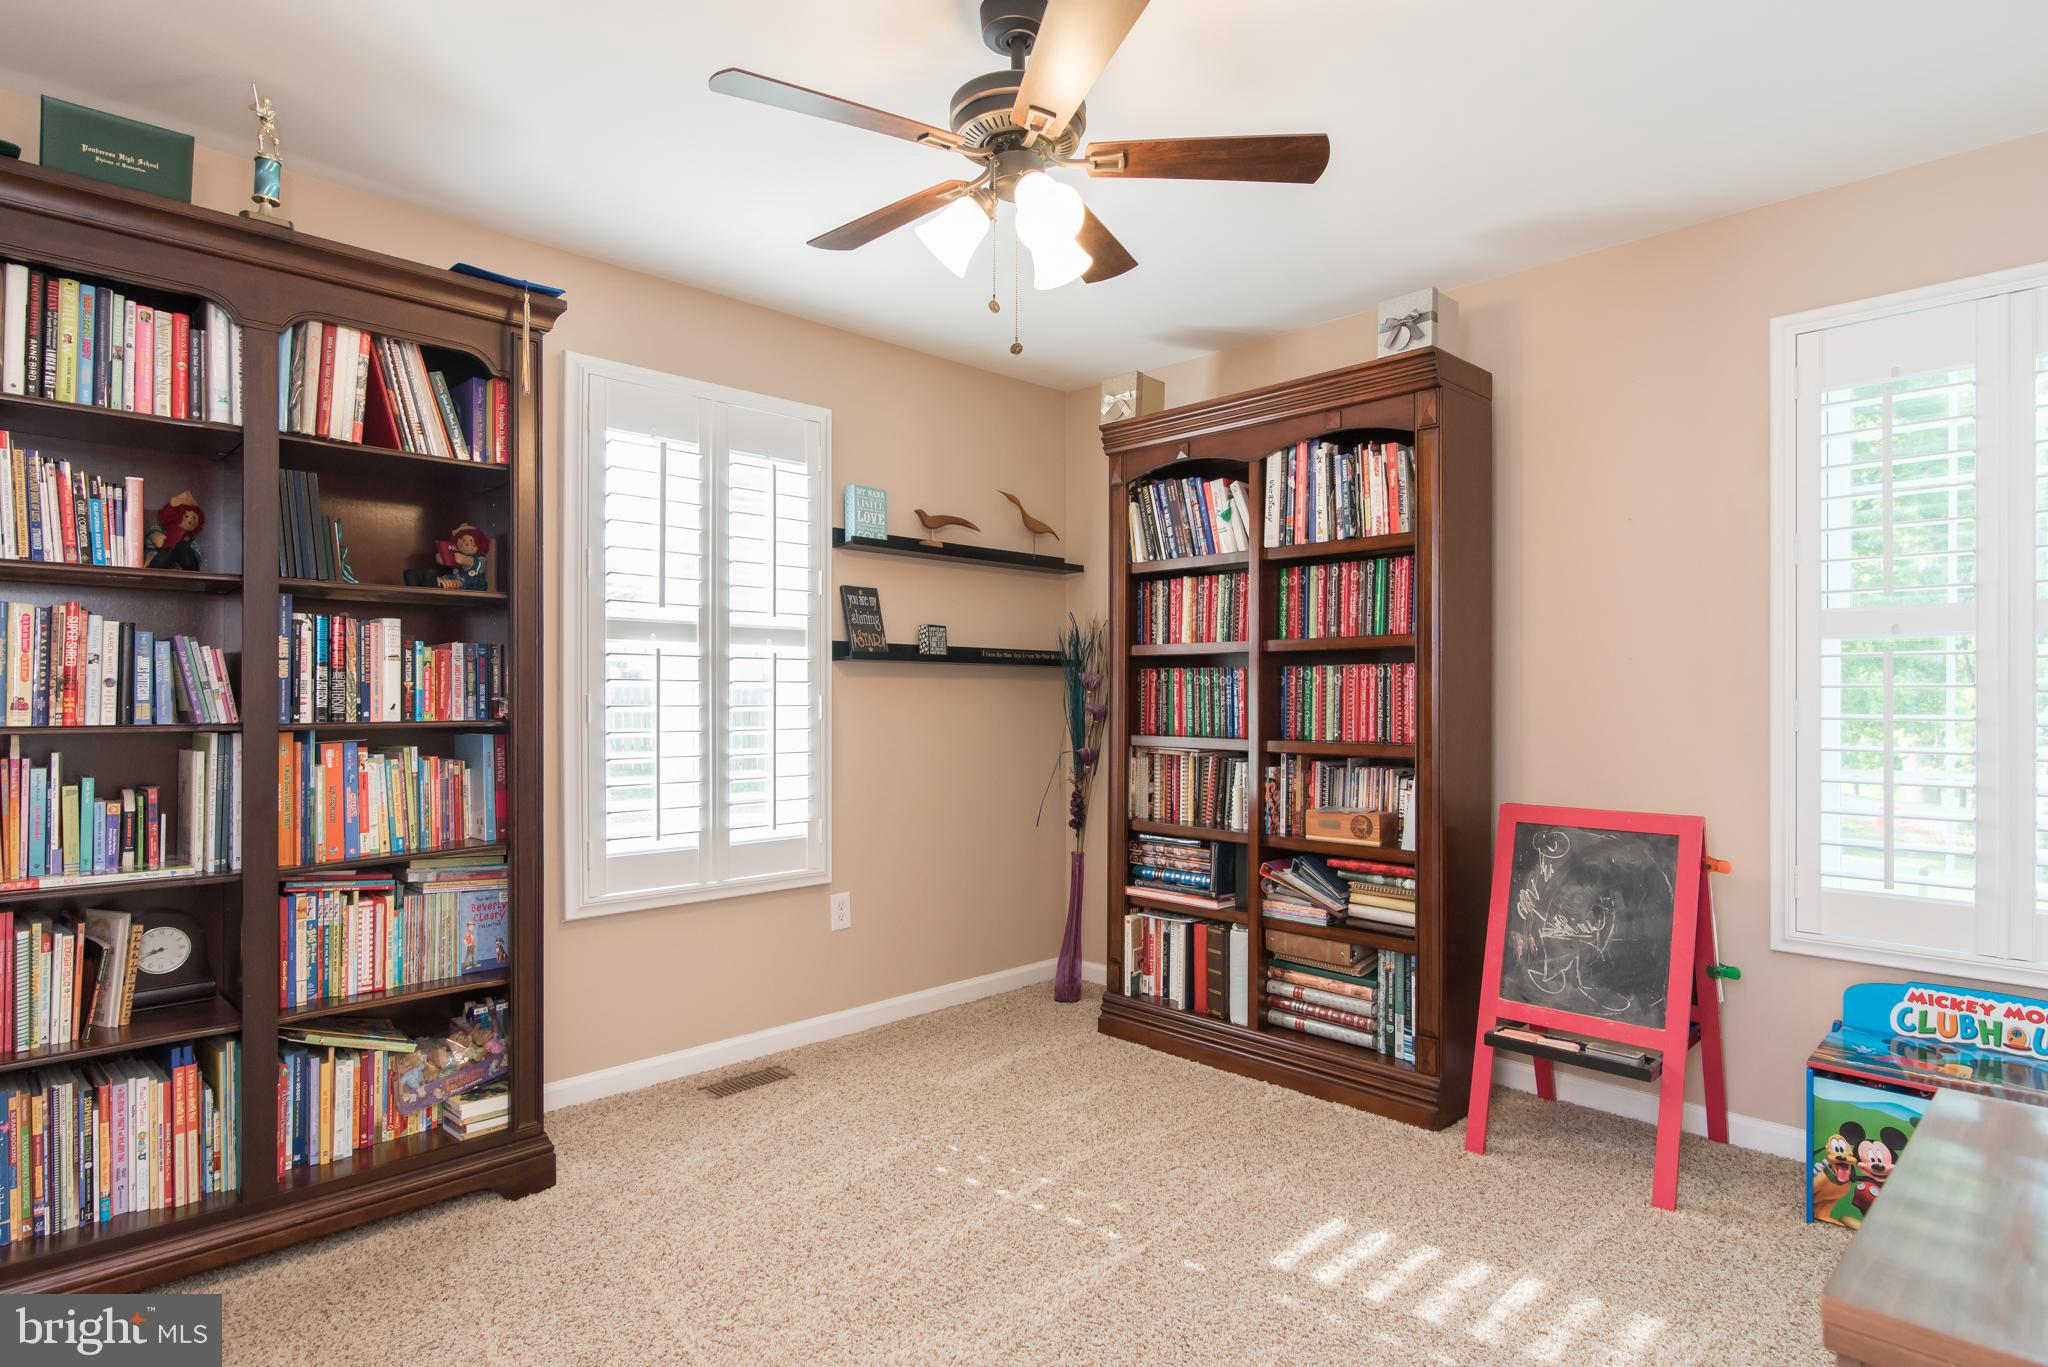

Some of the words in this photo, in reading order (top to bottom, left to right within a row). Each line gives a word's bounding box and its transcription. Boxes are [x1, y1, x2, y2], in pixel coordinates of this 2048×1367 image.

[118, 153, 135, 164] High
[30, 274, 40, 301] BLOOD
[62, 286, 74, 302] UP
[30, 302, 40, 336] BROTHER
[28, 339, 37, 361] ANNE
[27, 362, 37, 381] BIRD
[1343, 482, 1348, 492] WE
[92, 502, 100, 532] CALIFORNIA
[856, 510, 885, 526] LOVE
[1344, 508, 1350, 516] 12
[848, 594, 859, 608] you
[66, 616, 78, 641] SUPER
[851, 608, 882, 632] shining
[65, 642, 78, 666] SHRED
[279, 635, 288, 658] JAMES
[106, 655, 114, 675] WHITE
[136, 656, 150, 672] JAMES
[279, 660, 288, 678] BOND
[316, 667, 328, 680] JAMES
[136, 673, 150, 700] PATTERSON
[316, 681, 328, 708] PATTERSON
[331, 680, 345, 714] PATTERSON
[284, 795, 292, 812] SESAME
[1906, 990, 1997, 1017] MICKEY
[2002, 1005, 2048, 1027] MO
[84, 1096, 92, 1136] SCRAPBOOKING
[22, 1134, 30, 1178] SCRAPBOOKING
[22, 1179, 30, 1209] SOLUTIONS
